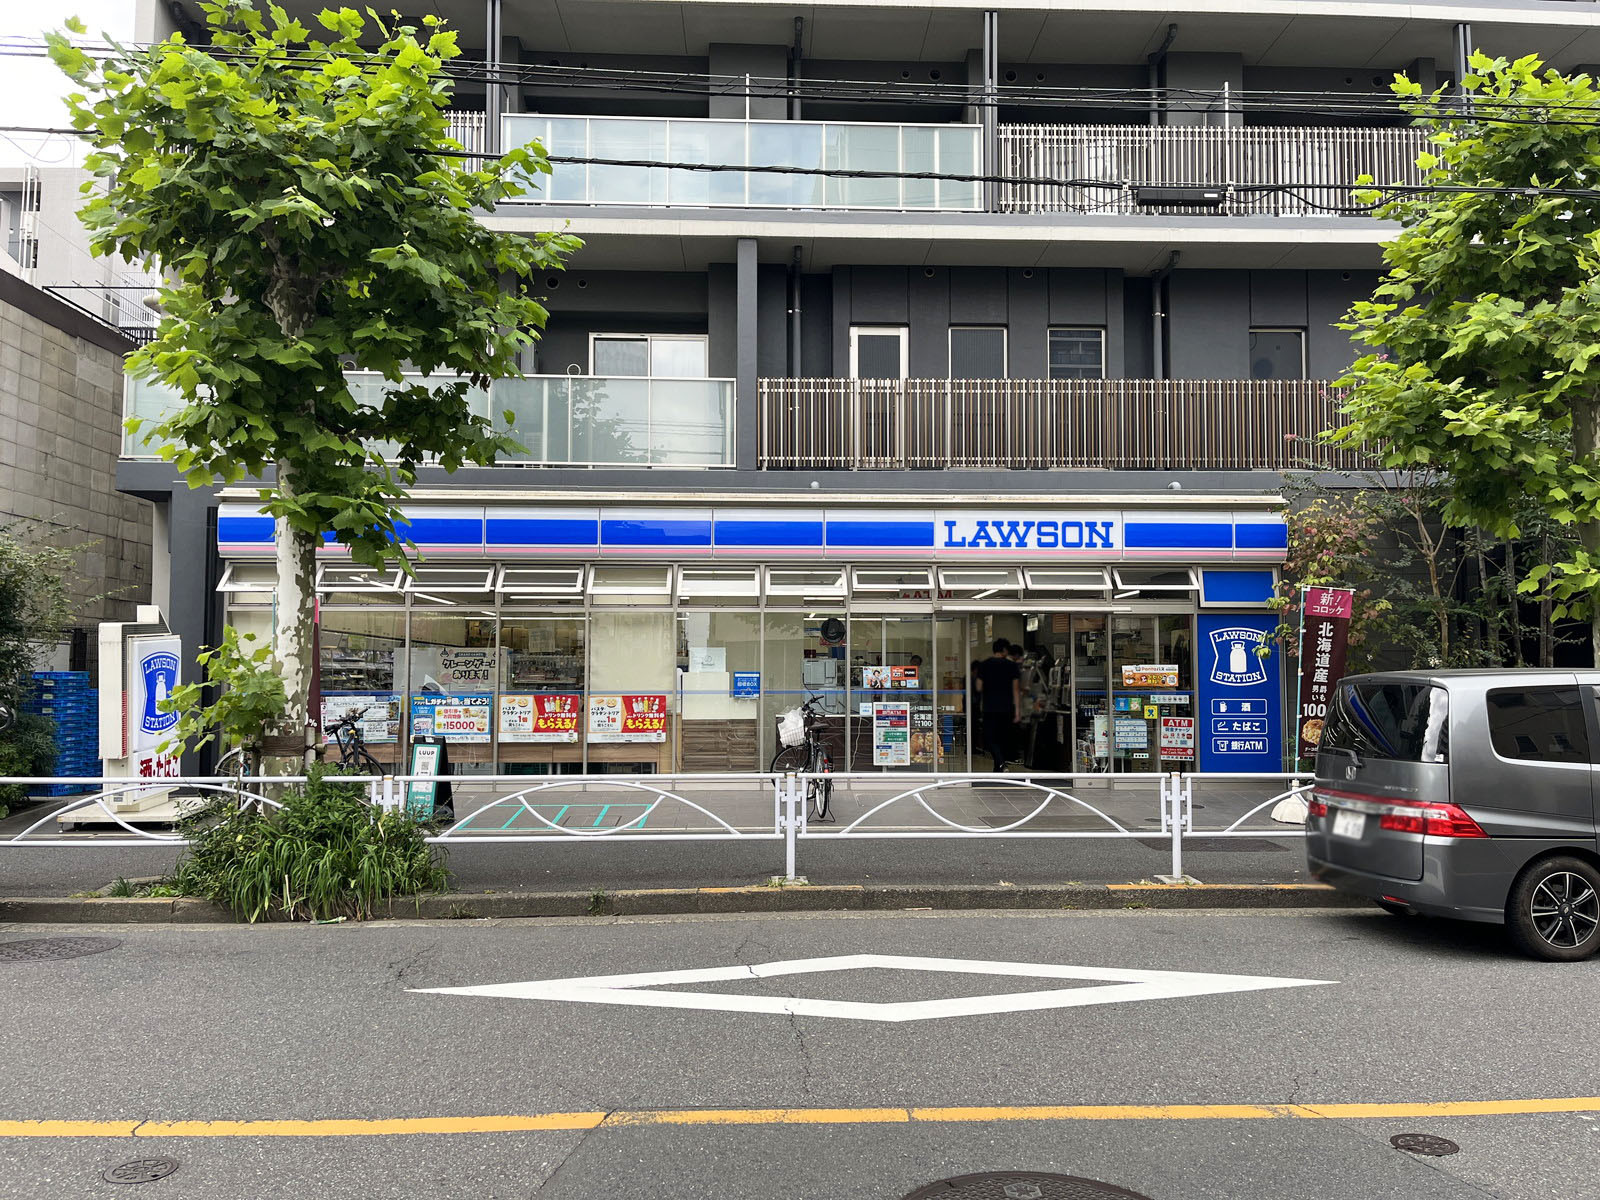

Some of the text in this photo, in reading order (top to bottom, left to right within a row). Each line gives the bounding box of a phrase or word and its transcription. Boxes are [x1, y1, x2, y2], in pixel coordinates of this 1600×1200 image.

[944, 520, 1113, 548] LAWSON
[1312, 606, 1344, 615] コロッケ
[1214, 631, 1262, 642] LAWSON
[1314, 622, 1333, 683] 北海道産
[144, 658, 177, 674] LAWSON
[453, 669, 488, 680] あります!
[1215, 671, 1262, 682] STATION
[1241, 702, 1251, 711] 酒
[144, 713, 177, 728] STATION
[538, 718, 576, 729] もらえる!
[626, 719, 665, 730] もらえる!
[1168, 719, 1188, 727] ATM
[1232, 721, 1261, 731] たばこ
[1231, 740, 1263, 751] 銀行ATM
